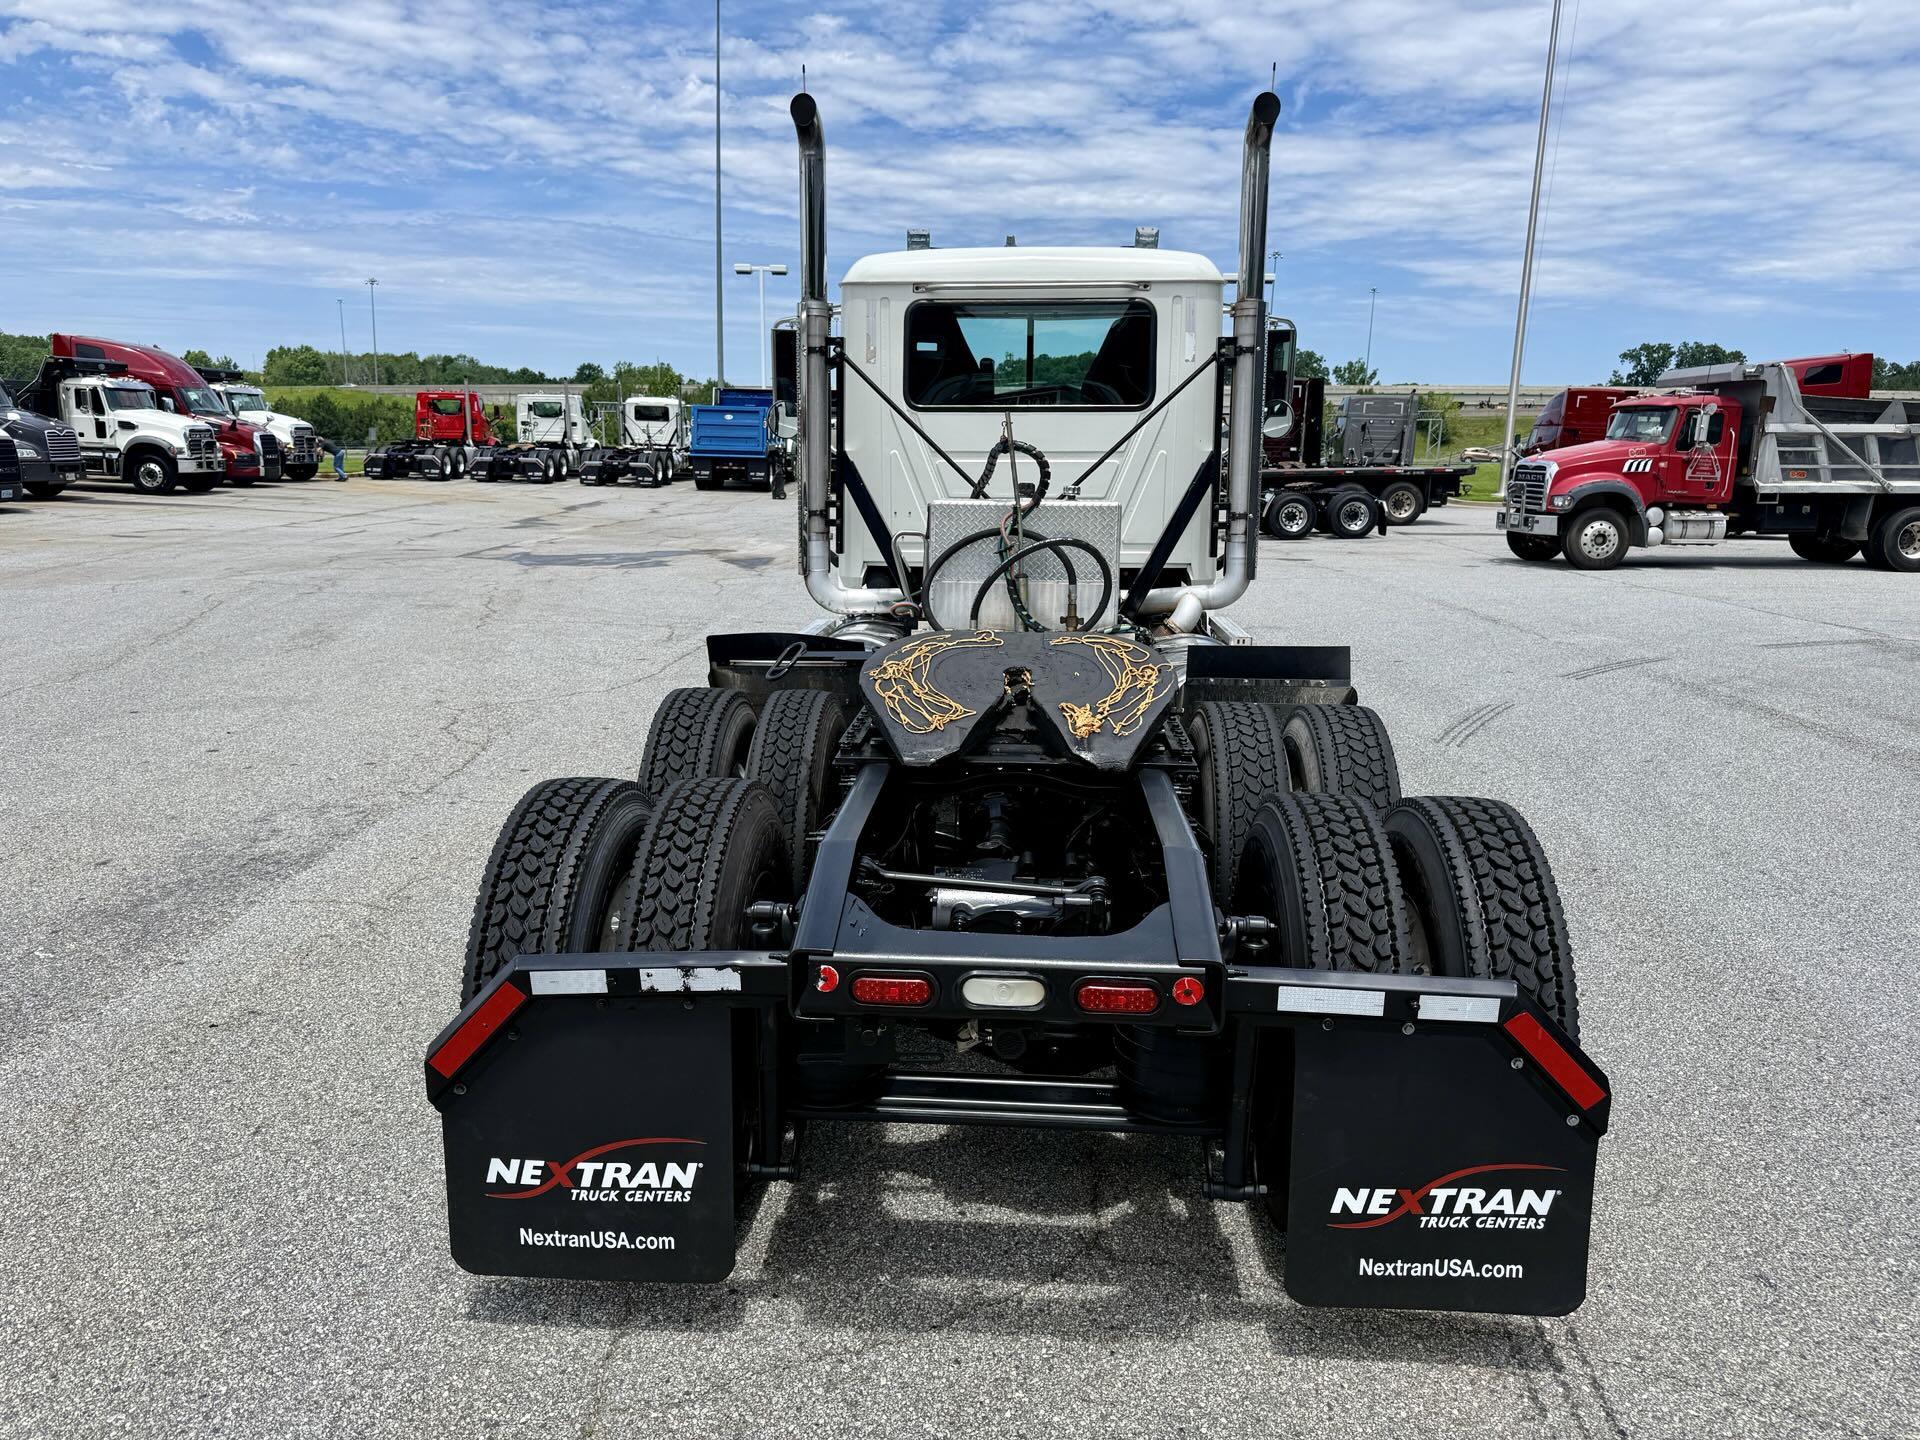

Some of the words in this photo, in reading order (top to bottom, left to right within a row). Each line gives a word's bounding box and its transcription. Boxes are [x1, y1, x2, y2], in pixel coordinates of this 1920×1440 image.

[570, 1189, 619, 1202] TRUCK
[624, 1189, 691, 1203] CENTERS
[1419, 1216, 1469, 1229] TRUCK
[1475, 1216, 1546, 1230] CENTERS
[519, 1227, 675, 1250] NextranUSA.com
[1358, 1258, 1523, 1279] NextranUSA.com
